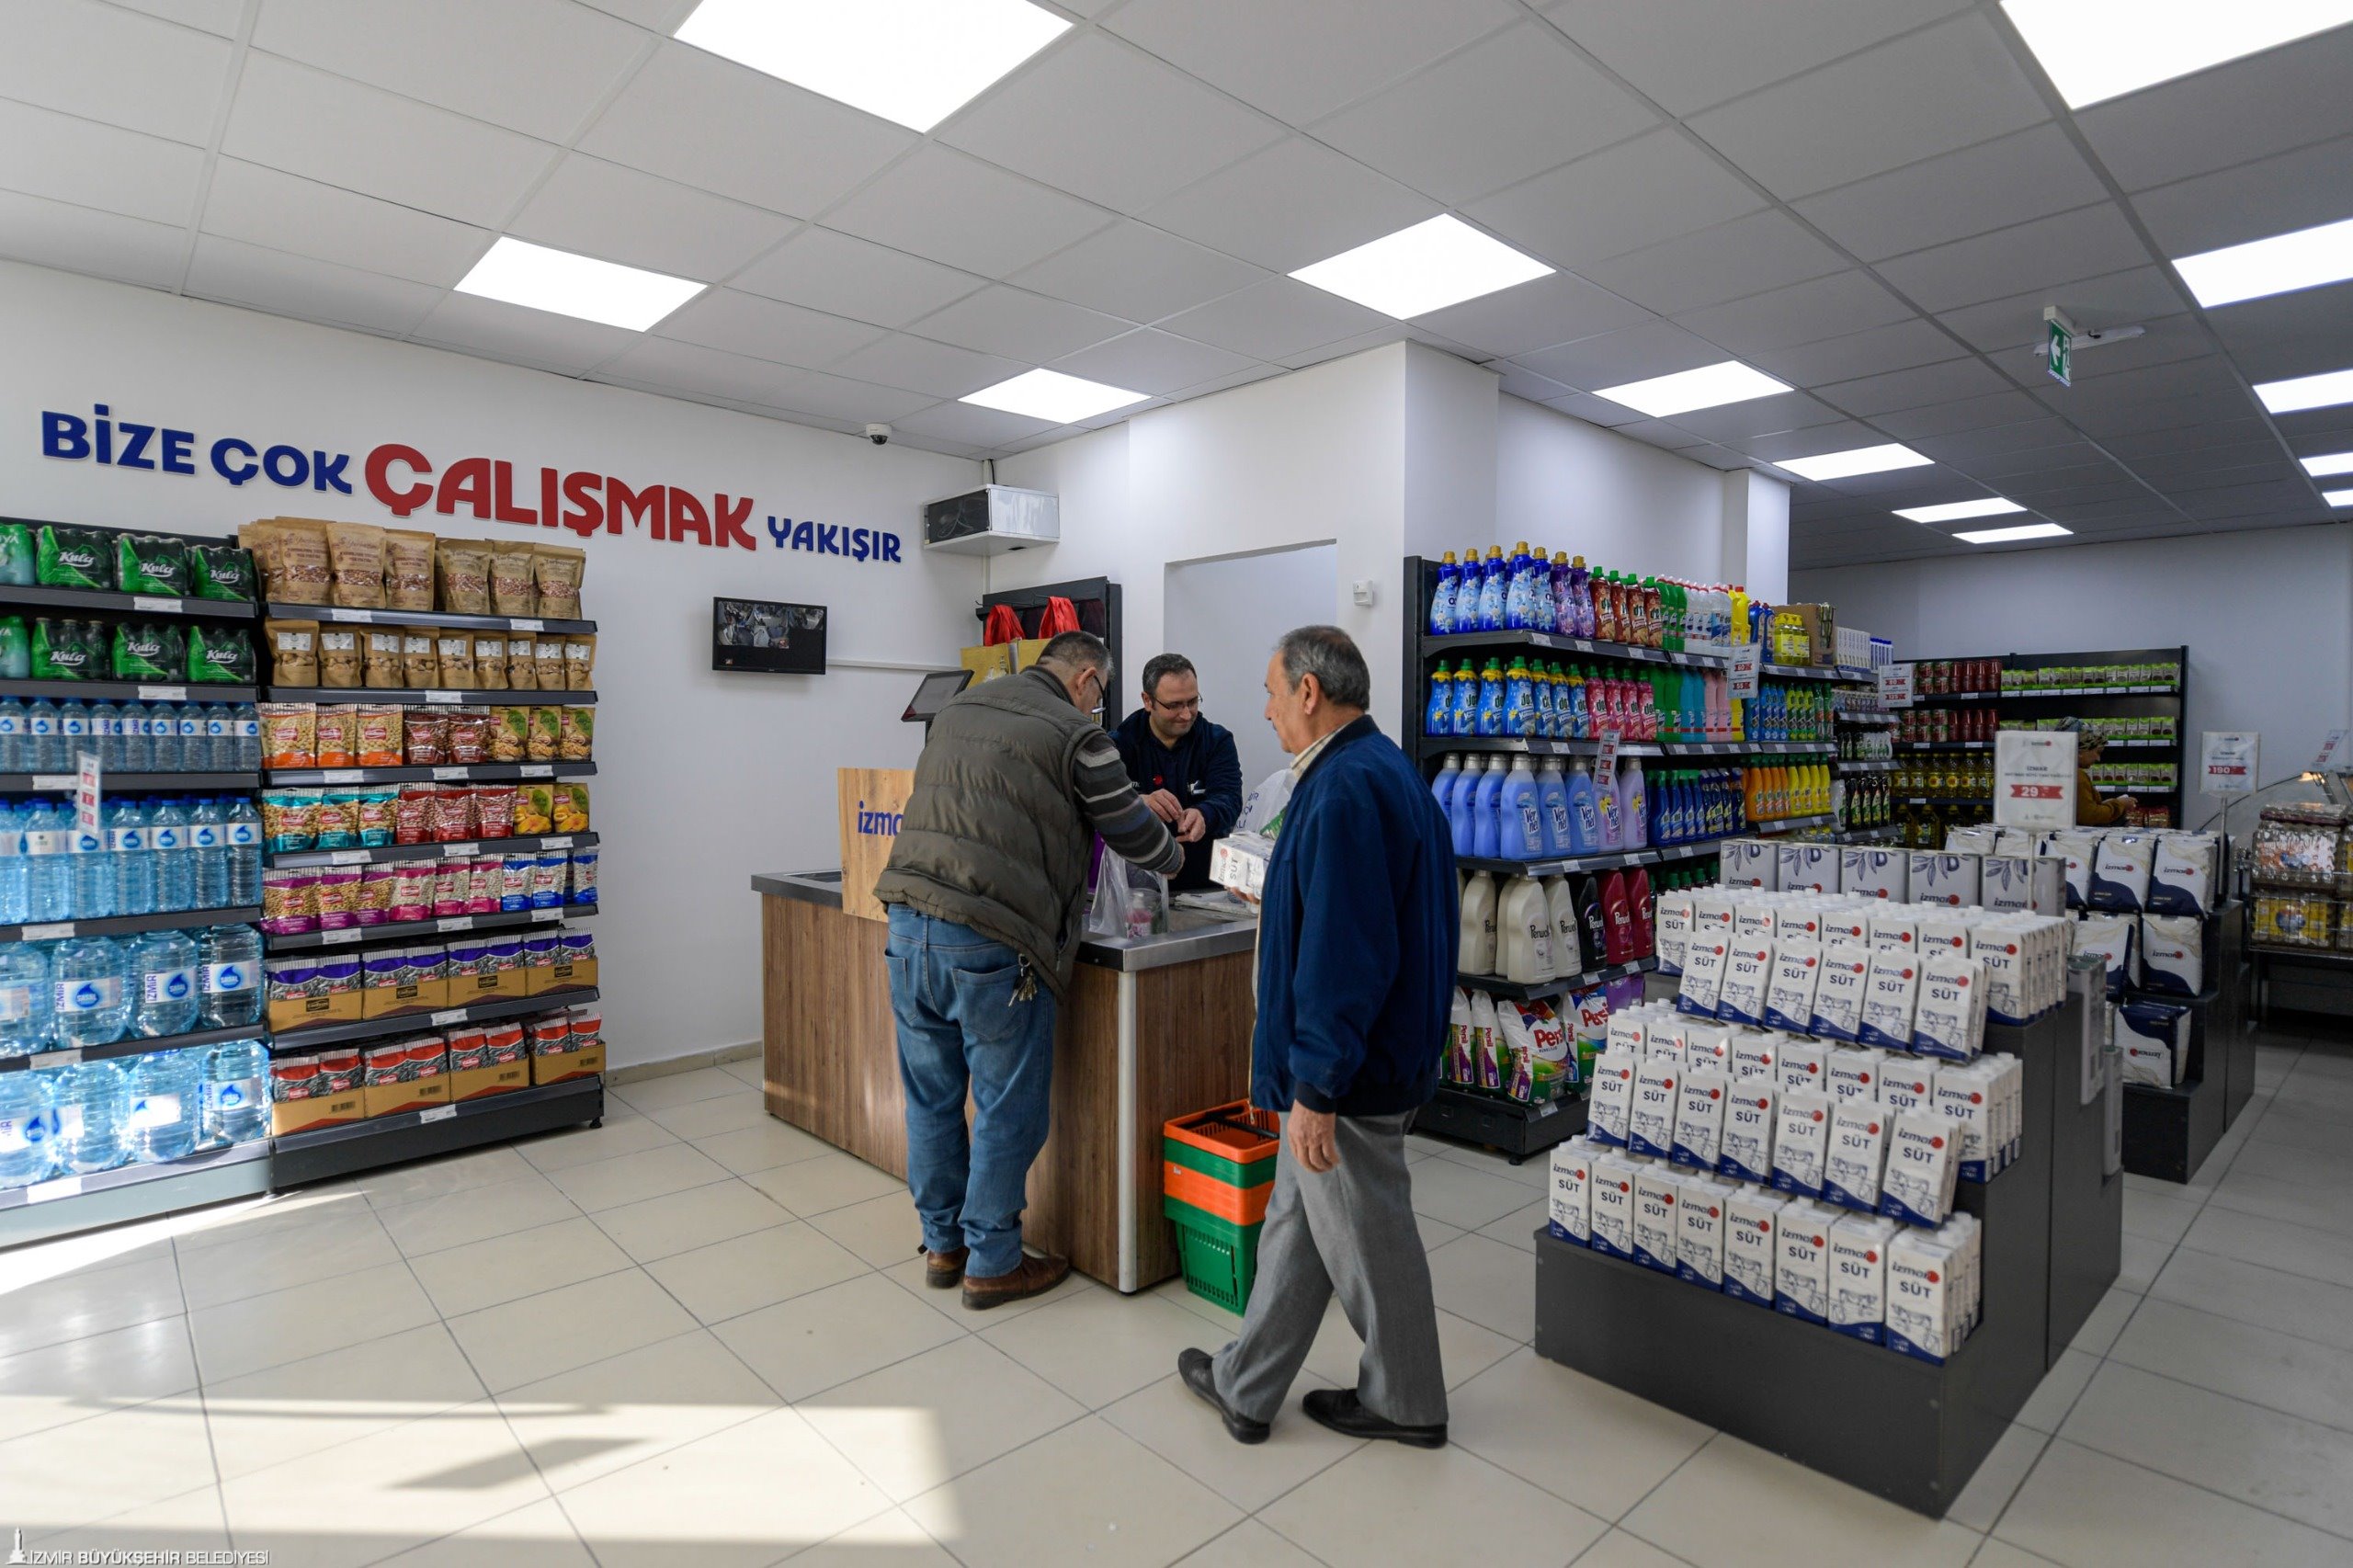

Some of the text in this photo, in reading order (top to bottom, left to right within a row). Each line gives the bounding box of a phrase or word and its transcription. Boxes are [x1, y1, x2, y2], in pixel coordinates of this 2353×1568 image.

[41, 403, 195, 475] BİZE
[210, 437, 353, 494] ÇOK
[365, 443, 756, 551] ÇALIŞMAK
[767, 515, 902, 564] YAKIŞIR
[1665, 920, 1685, 930] SÜT
[1694, 957, 1717, 968] SÜT
[1735, 962, 1759, 973] SÜT
[1984, 957, 2011, 969] SÜT
[1783, 968, 1808, 980] SÜT
[1830, 974, 1856, 987] SÜT
[1878, 981, 1905, 993] SÜT
[1931, 988, 1961, 1001] SÜT
[1581, 1003, 1608, 1028] Persi
[1534, 1028, 1563, 1049] Pers
[1601, 1080, 1623, 1093] SÜT
[1643, 1090, 1666, 1103] SÜT
[1688, 1100, 1713, 1114] SÜT
[1945, 1105, 1974, 1119] SÜT
[1735, 1110, 1761, 1124] SÜT
[1788, 1122, 1816, 1137] SÜT
[1841, 1133, 1871, 1149] SÜT
[1903, 1147, 1935, 1164] SÜT
[1558, 1178, 1580, 1193] SÜT
[1600, 1191, 1624, 1206] SÜT
[1643, 1202, 1668, 1218] SÜT
[1688, 1216, 1713, 1232] SÜT
[1736, 1230, 1763, 1246] SÜT
[1789, 1245, 1817, 1262] SÜT
[1840, 1261, 1870, 1278] SÜT
[1900, 1280, 1932, 1300] SÜT
